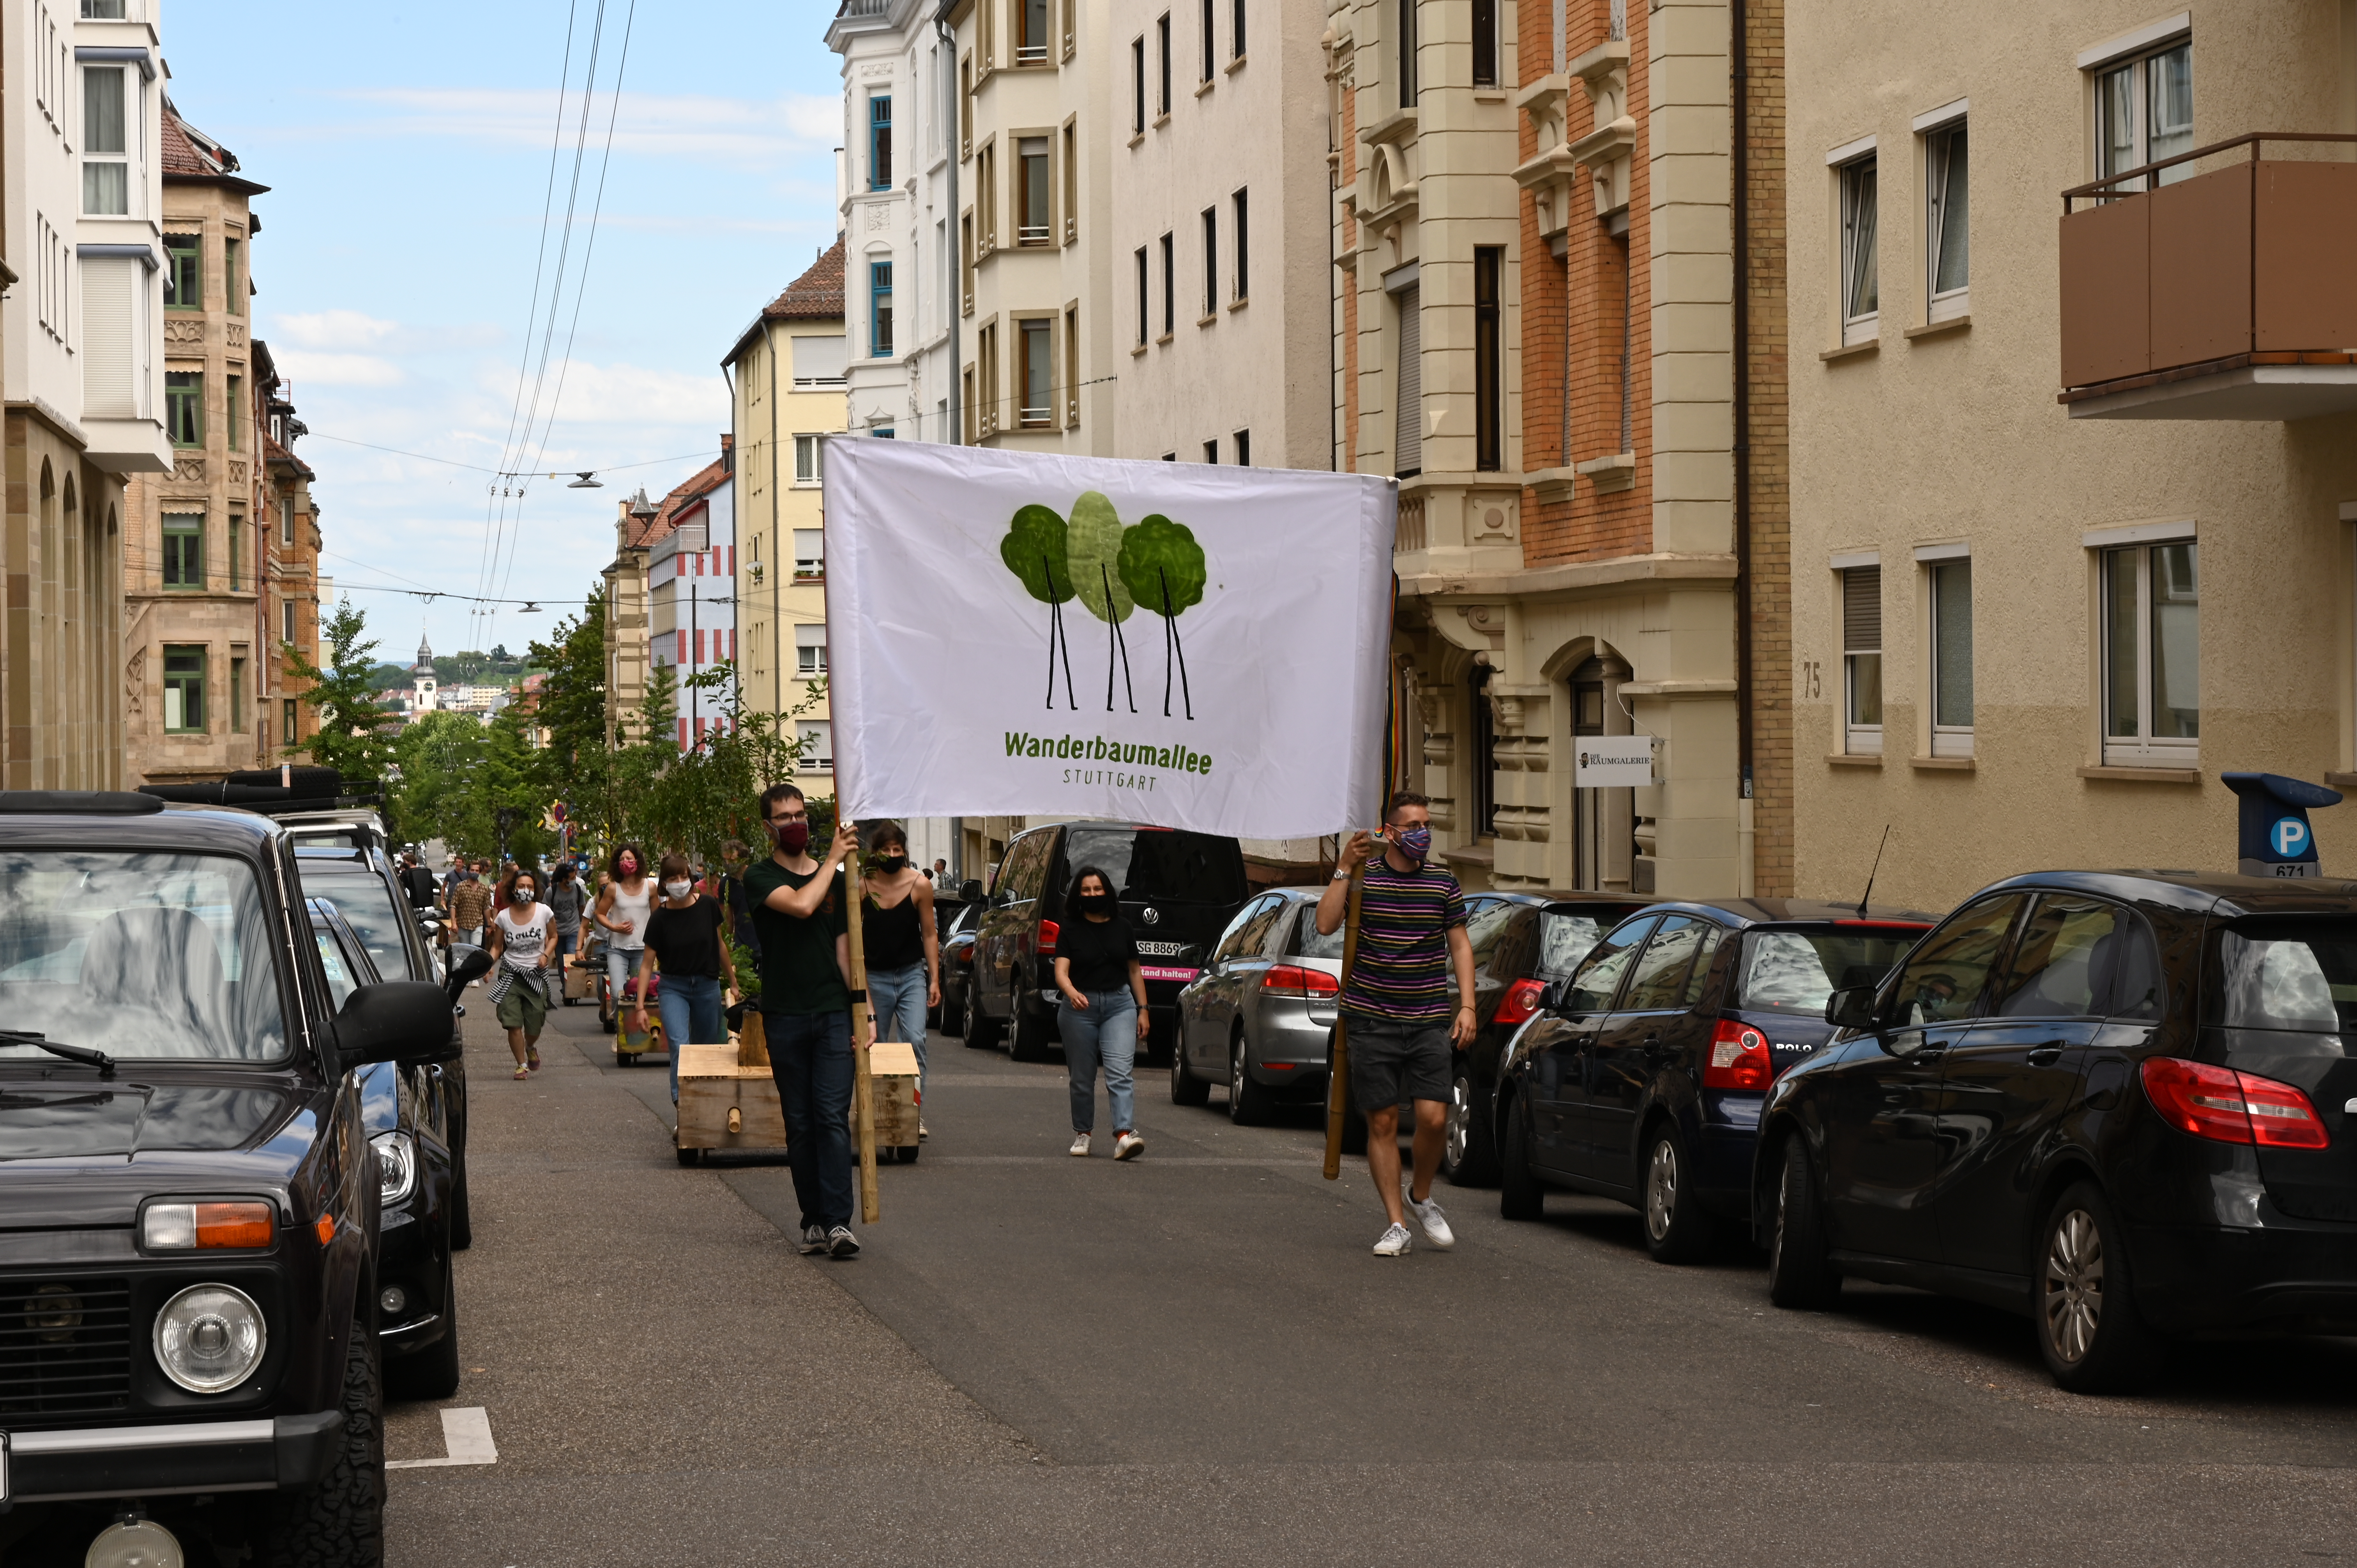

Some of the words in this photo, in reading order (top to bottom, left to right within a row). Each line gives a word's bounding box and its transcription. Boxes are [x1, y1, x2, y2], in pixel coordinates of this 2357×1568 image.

[1804, 662, 1820, 699] 75
[1005, 732, 1212, 775] Wanderbaumallee
[1063, 769, 1156, 791] STUTTGART
[2280, 821, 2304, 853] P
[580, 861, 585, 869] P
[2276, 865, 2304, 876] 671
[506, 927, 541, 943] South
[1162, 969, 1191, 978] halten!
[1776, 1043, 1812, 1052] POLO
